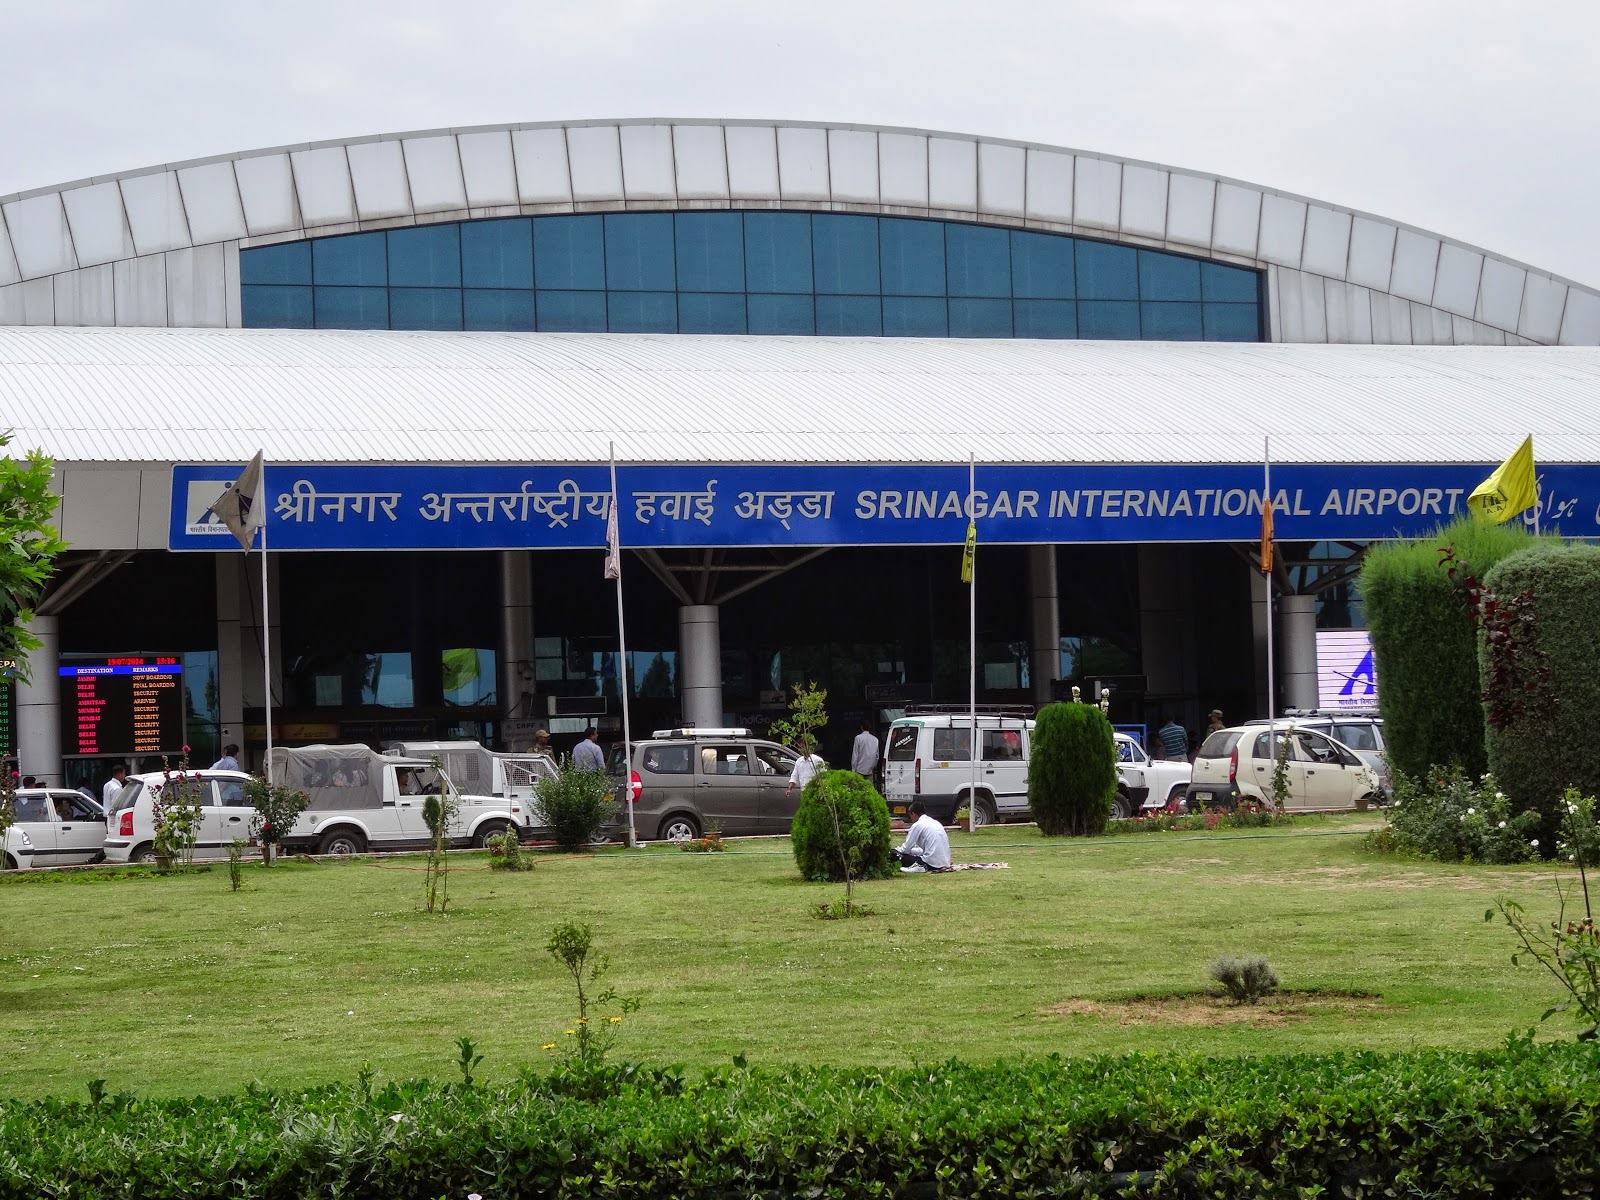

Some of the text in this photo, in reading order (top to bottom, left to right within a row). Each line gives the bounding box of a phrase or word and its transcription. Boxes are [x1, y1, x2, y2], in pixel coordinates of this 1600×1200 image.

[273, 479, 402, 522] श्रीनगर
[418, 479, 612, 529] अन्तर्राष्ट्रीय
[632, 479, 718, 526] हवाई
[855, 490, 1040, 519] SRINAGAR
[1048, 488, 1311, 518] INTERNATIONAL
[1320, 487, 1464, 515] AIRPORT
